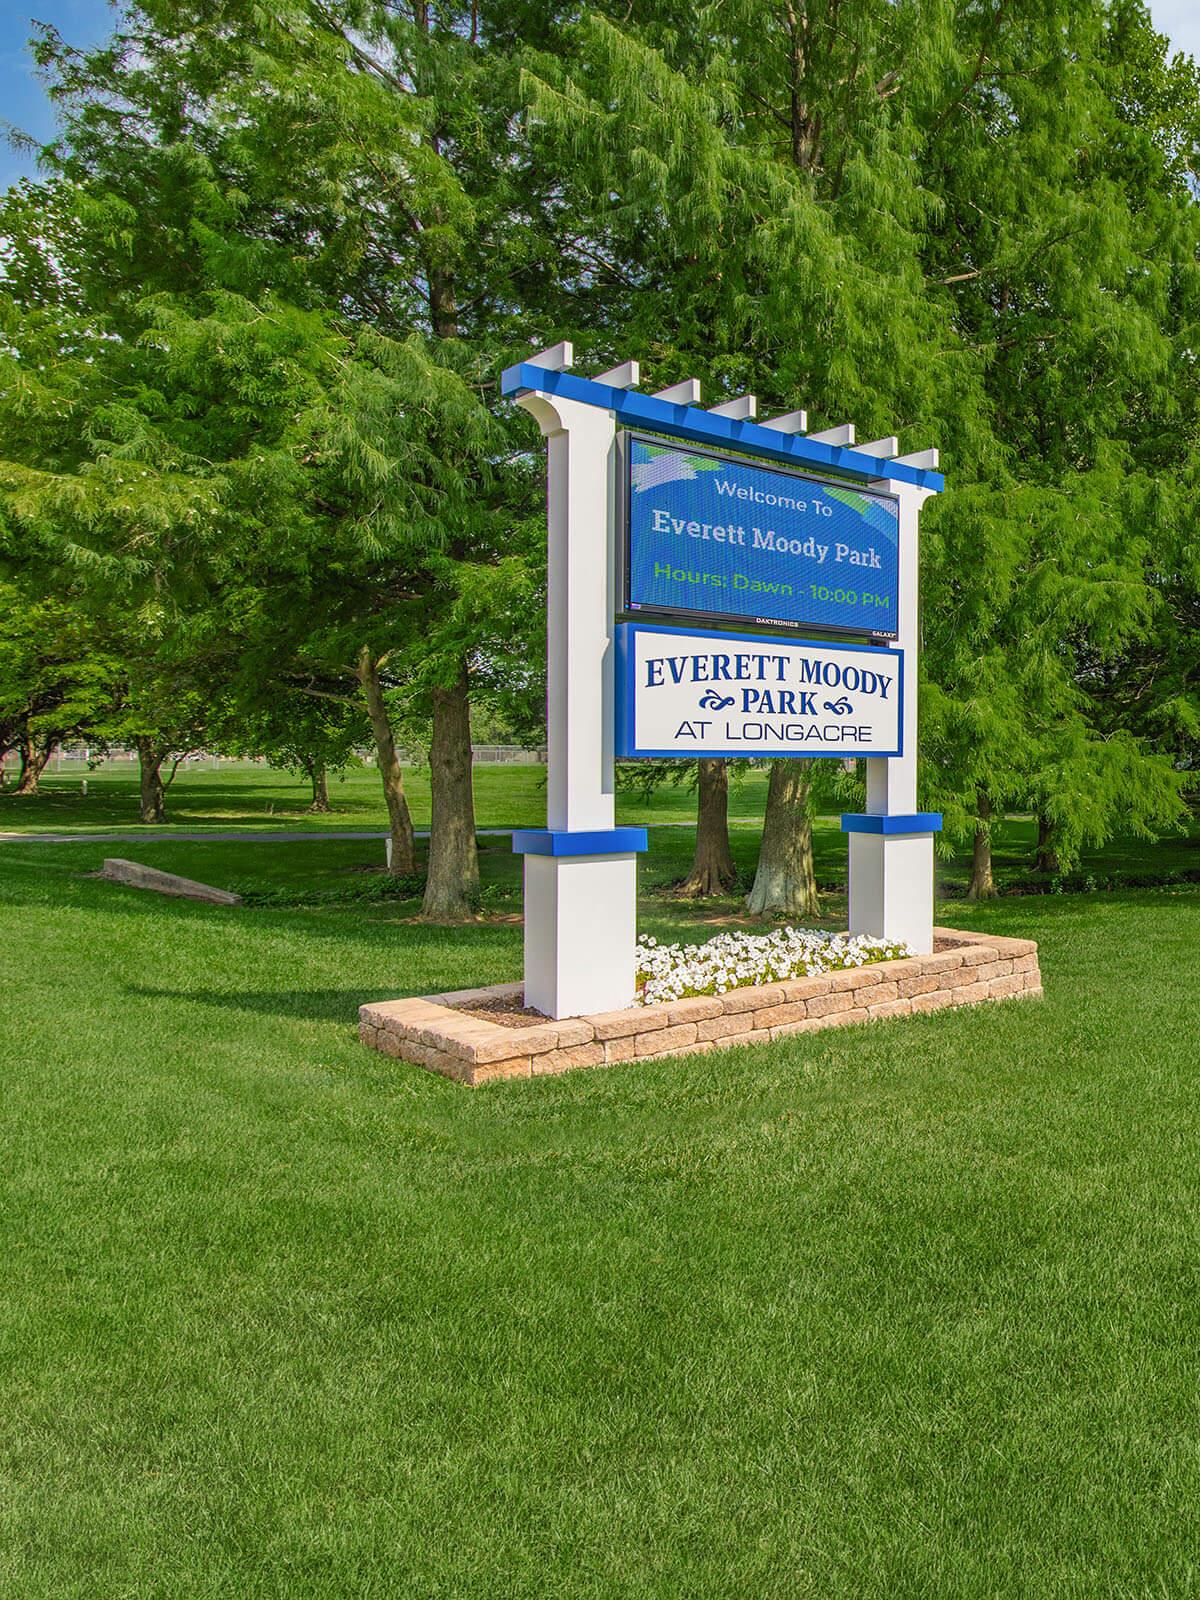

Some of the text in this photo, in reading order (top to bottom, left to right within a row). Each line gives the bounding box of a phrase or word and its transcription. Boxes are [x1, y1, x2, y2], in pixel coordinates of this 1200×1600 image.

[715, 479, 832, 517] Welcome To
[652, 510, 881, 568] Everett Moody Park
[654, 562, 727, 587] Hours:
[733, 573, 792, 596] Dawn
[810, 585, 857, 604] 10:00
[862, 592, 889, 609] PM
[756, 618, 799, 627] DAKTRONICS
[645, 654, 893, 699] EVERETT MOODY
[741, 688, 818, 715] PARK
[674, 721, 873, 742] AT LONGACRE
